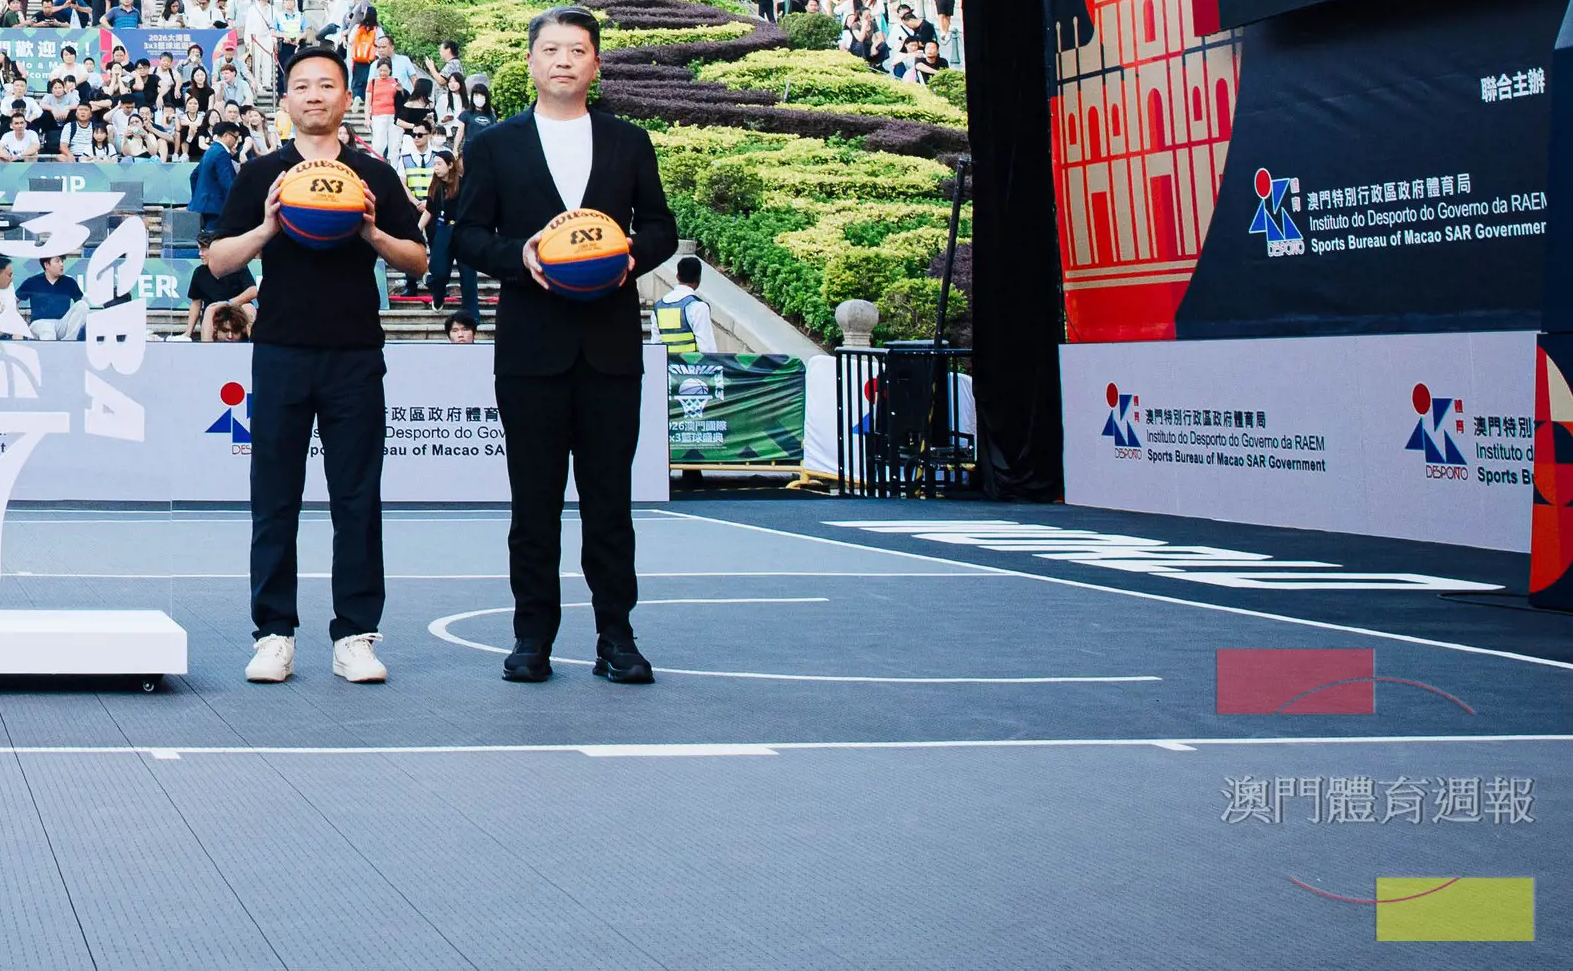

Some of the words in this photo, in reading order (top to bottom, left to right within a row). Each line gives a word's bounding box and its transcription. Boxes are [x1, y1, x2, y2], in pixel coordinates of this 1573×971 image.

[1480, 67, 1546, 103] 聯合主辦
[296, 160, 355, 178] Wilson
[1307, 173, 1471, 212] 澳門特別行政區政府體育局
[549, 211, 611, 230] Wilson
[1309, 210, 1349, 232] Instituto
[1351, 208, 1366, 227] do
[1367, 204, 1418, 229] Desporto
[1420, 200, 1435, 220] do
[1437, 196, 1489, 219] Governo
[1491, 196, 1508, 214] da
[1311, 234, 1345, 256] Sports
[1348, 233, 1387, 251] Bureau
[1390, 229, 1403, 246] of
[1404, 227, 1442, 245] Macao
[1444, 225, 1472, 241] SAR
[1145, 408, 1267, 429] 澳門特別行政區政府體育局
[385, 426, 450, 441] Desporto
[454, 426, 472, 439] do
[1147, 429, 1176, 445] Instituto
[1177, 430, 1189, 445] do
[1190, 430, 1227, 448] Desporto
[1228, 433, 1240, 447] do
[1241, 433, 1279, 449] Governo
[1281, 434, 1293, 450] da
[1294, 434, 1325, 451] RAEM
[383, 445, 407, 456] eau
[411, 443, 426, 456] of
[431, 443, 479, 456] Macao
[484, 443, 505, 456] SA
[1147, 448, 1173, 463] Sports
[1175, 450, 1204, 465] Bureau
[1206, 450, 1216, 465] of
[1216, 452, 1245, 467] Macao
[1246, 454, 1266, 468] SAR
[1268, 455, 1326, 472] Government
[1476, 442, 1523, 461] Instituto
[1525, 444, 1534, 461] d
[1426, 464, 1469, 481] DESPORTO
[1477, 466, 1518, 487] Sports
